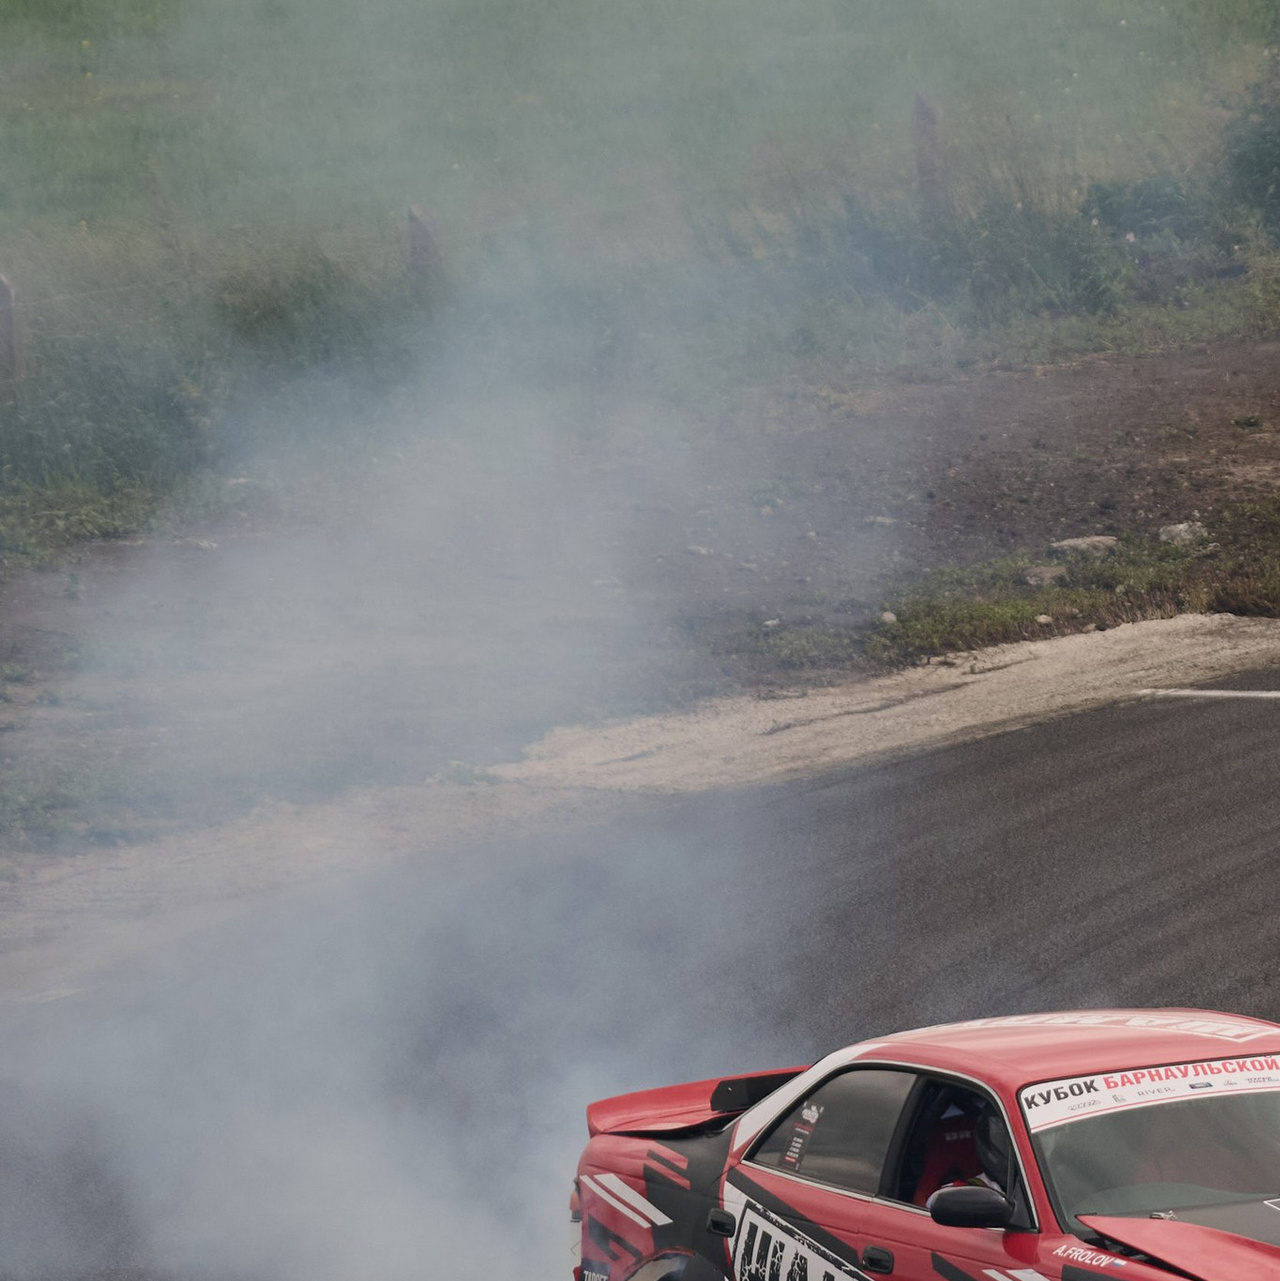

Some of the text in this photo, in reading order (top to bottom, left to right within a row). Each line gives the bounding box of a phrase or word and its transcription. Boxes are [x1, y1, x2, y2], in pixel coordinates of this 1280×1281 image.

[1023, 1079, 1100, 1109] КУБОК
[1103, 1056, 1280, 1090] БАРНАУЛЬСКОЙ
[1053, 1245, 1115, 1267] A.FROLOV
